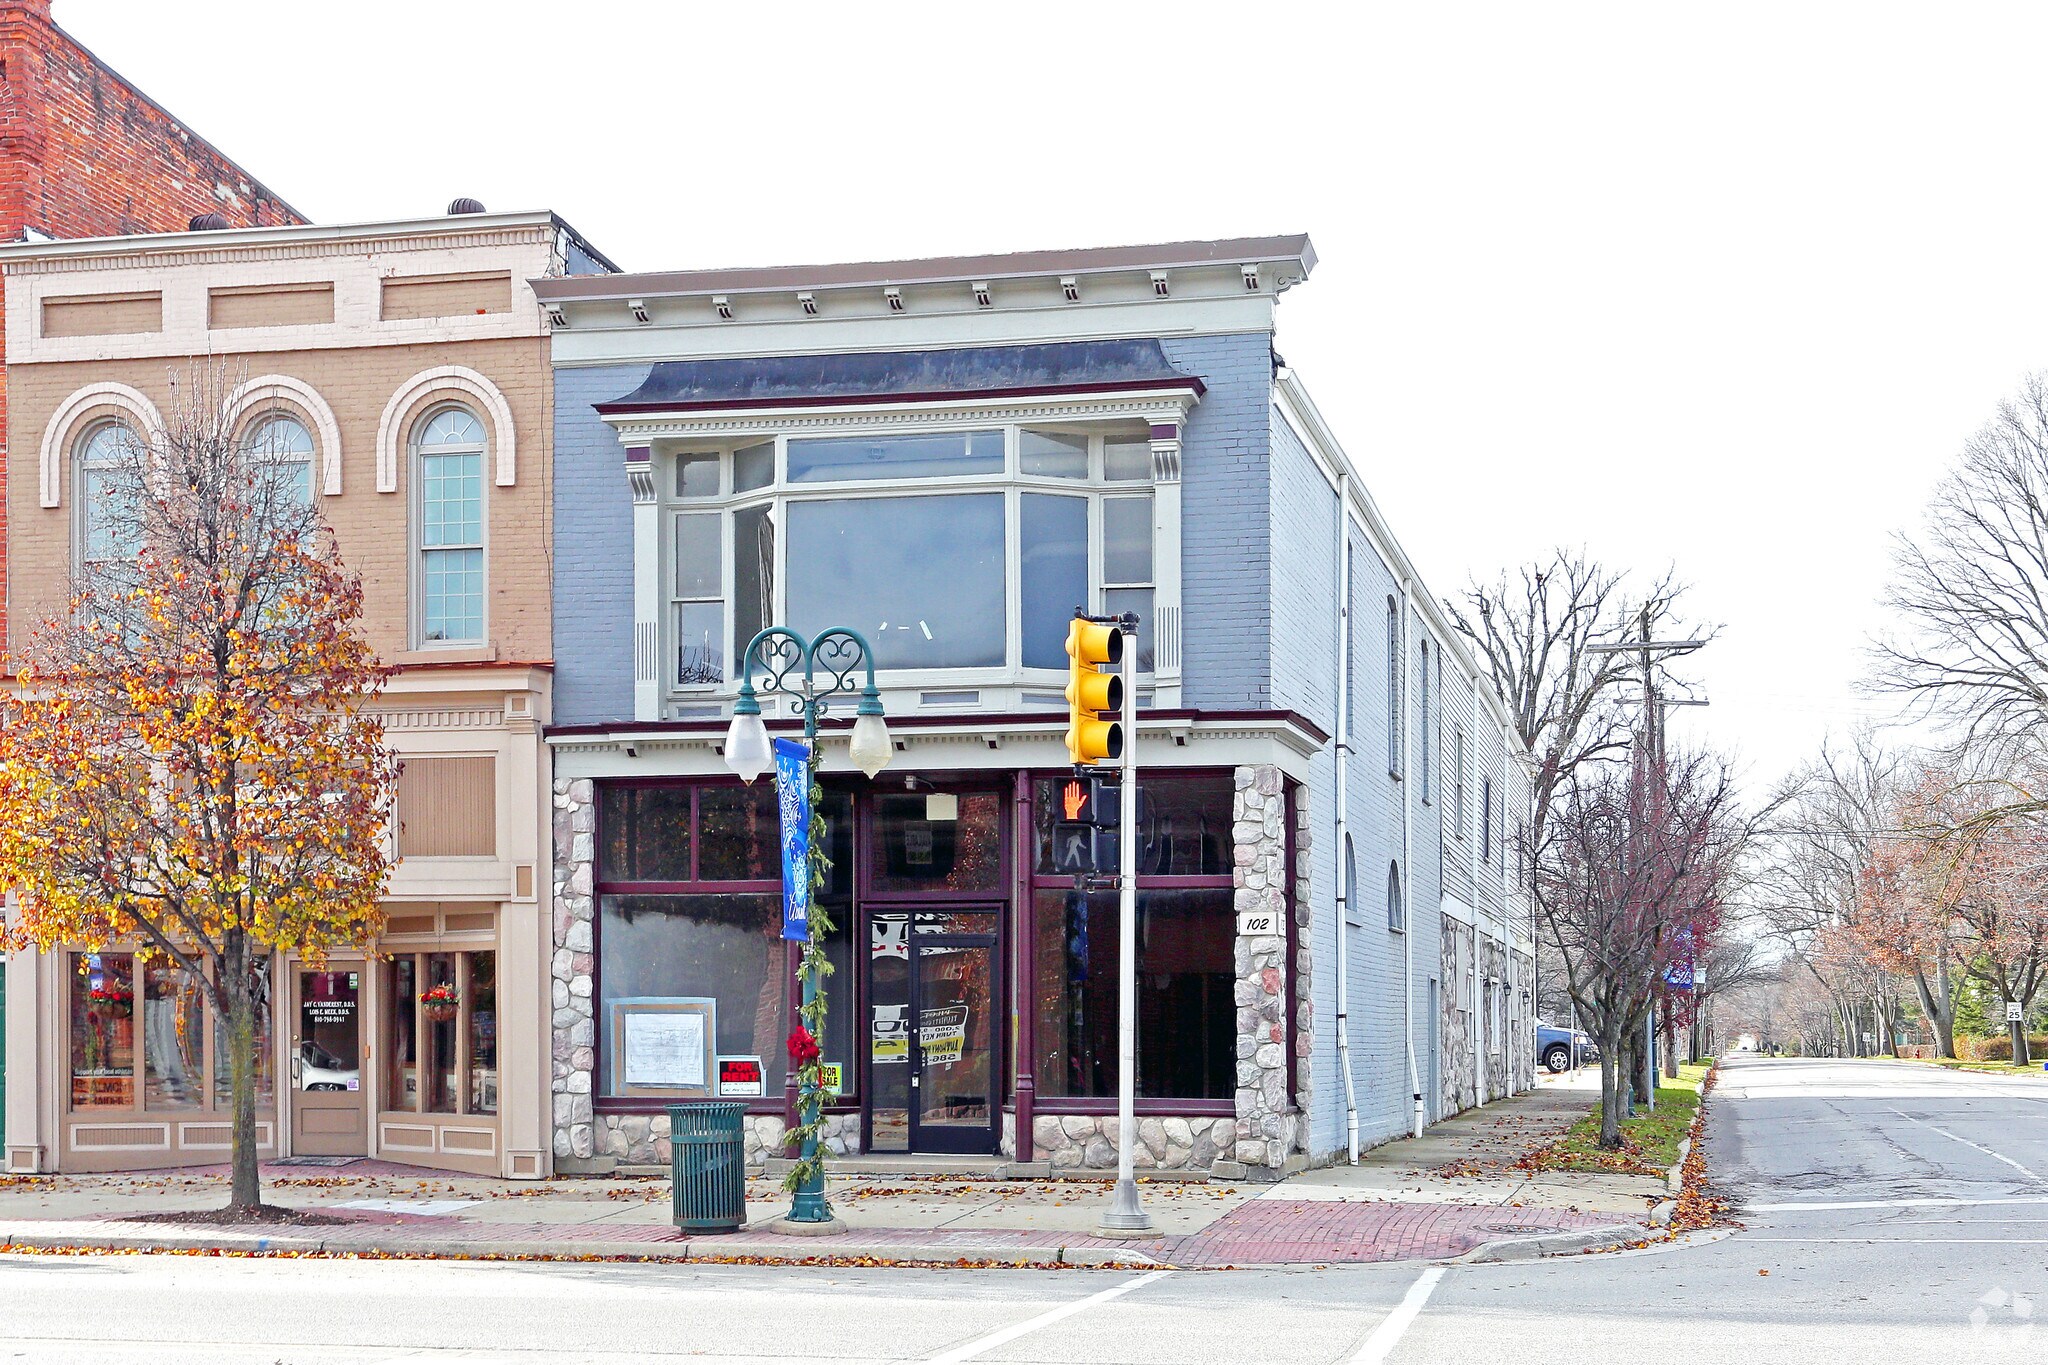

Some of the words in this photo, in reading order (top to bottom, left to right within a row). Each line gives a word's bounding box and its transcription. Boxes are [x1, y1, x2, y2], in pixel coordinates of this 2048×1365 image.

[1246, 918, 1269, 930] 102
[2008, 1011, 2021, 1019] 25
[728, 1062, 752, 1071] FOR
[722, 1072, 758, 1081] RENT
